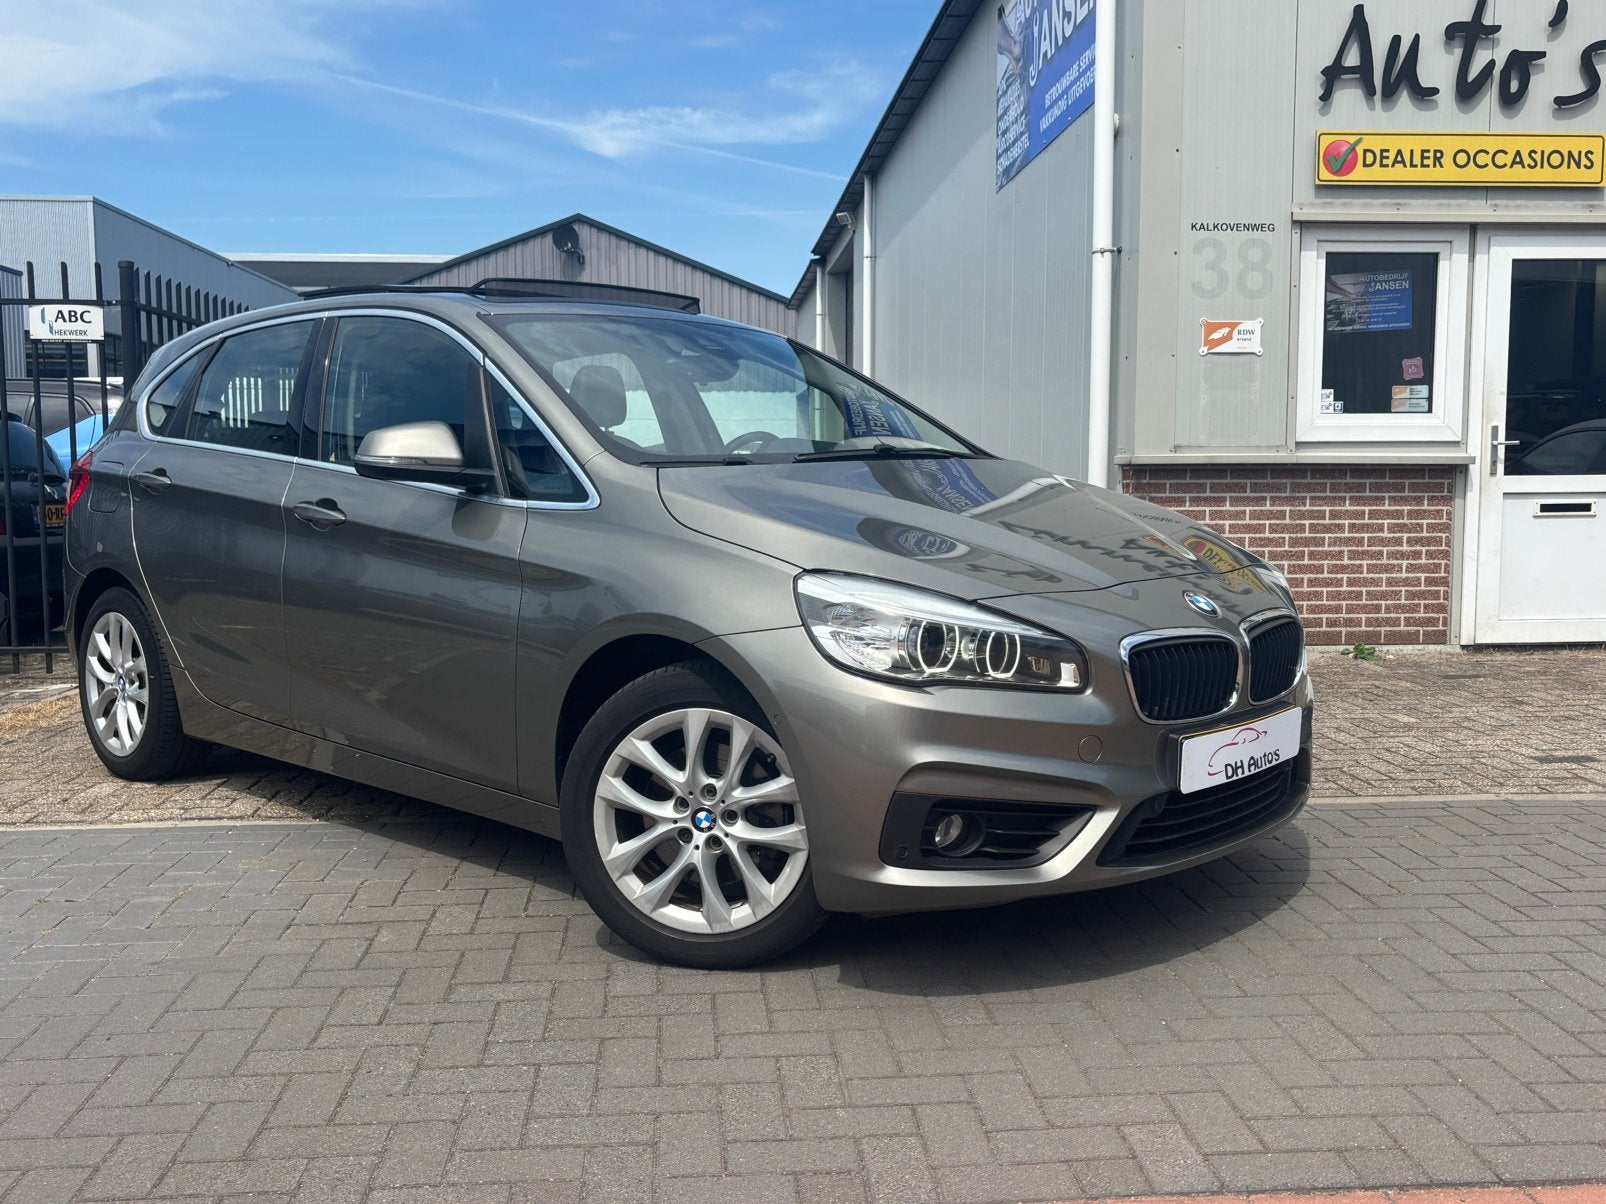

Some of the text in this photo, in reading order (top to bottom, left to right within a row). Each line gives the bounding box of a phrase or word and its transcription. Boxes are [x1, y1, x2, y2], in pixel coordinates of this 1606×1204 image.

[1029, 0, 1094, 87] JANSE
[1319, 0, 1606, 106] Auto's
[1044, 61, 1079, 108] BETROUWBARE
[1039, 65, 1096, 133] VAKKUNDIG UITGEVOE
[1362, 149, 1595, 170] DEALER OCCASIONS
[1191, 222, 1276, 232] KALKOVENWEG
[1190, 236, 1274, 300] 38
[1359, 273, 1409, 282] AUTOBEDRIJF
[1369, 281, 1409, 292] JANSEN
[54, 309, 92, 324] ABC
[54, 329, 89, 337] HEKWERK
[1224, 748, 1280, 780] DH Auto's
